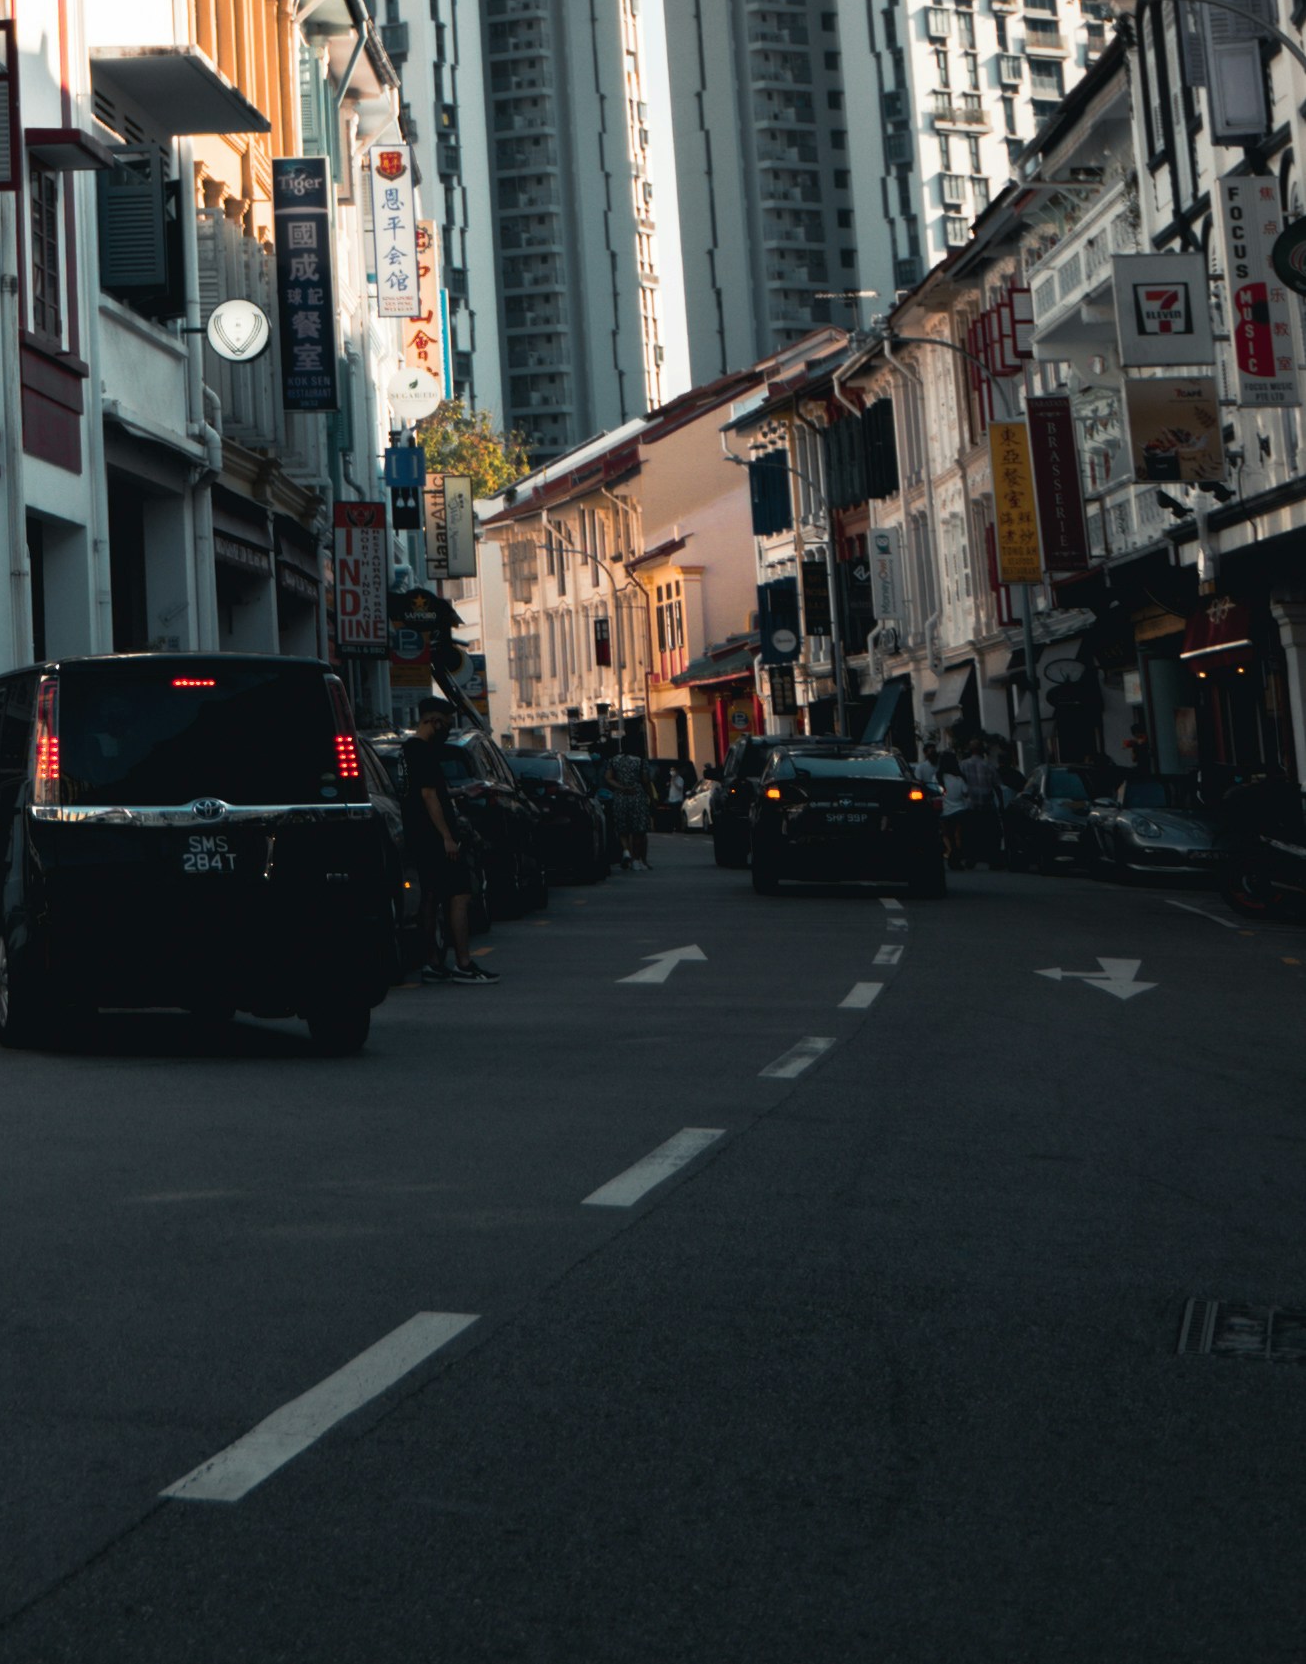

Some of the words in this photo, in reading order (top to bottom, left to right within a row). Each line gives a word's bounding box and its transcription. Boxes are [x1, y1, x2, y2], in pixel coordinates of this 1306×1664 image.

[277, 174, 324, 196] Tiger
[381, 188, 409, 292] 恩平会馆
[1228, 187, 1249, 278] FOCUS
[1145, 290, 1178, 333] 7
[1240, 290, 1258, 372] MUSIC
[288, 376, 308, 387] KOK
[310, 375, 331, 386] SEN
[1244, 382, 1268, 392] FOCUS
[1270, 382, 1294, 392] MUSIC
[287, 388, 332, 400] RESTAURANT
[1255, 392, 1270, 402] PTE
[1271, 392, 1286, 402] LTD
[1046, 422, 1069, 547] BRASSERIE
[361, 530, 369, 567] NORTH
[1001, 546, 1024, 556] TONG
[372, 530, 381, 592] RESTAURANT
[362, 575, 371, 620] INDIAN
[374, 602, 382, 620] BAR
[404, 611, 437, 620] SAPPORO
[189, 835, 228, 852] SMS
[183, 853, 236, 871] 284T
